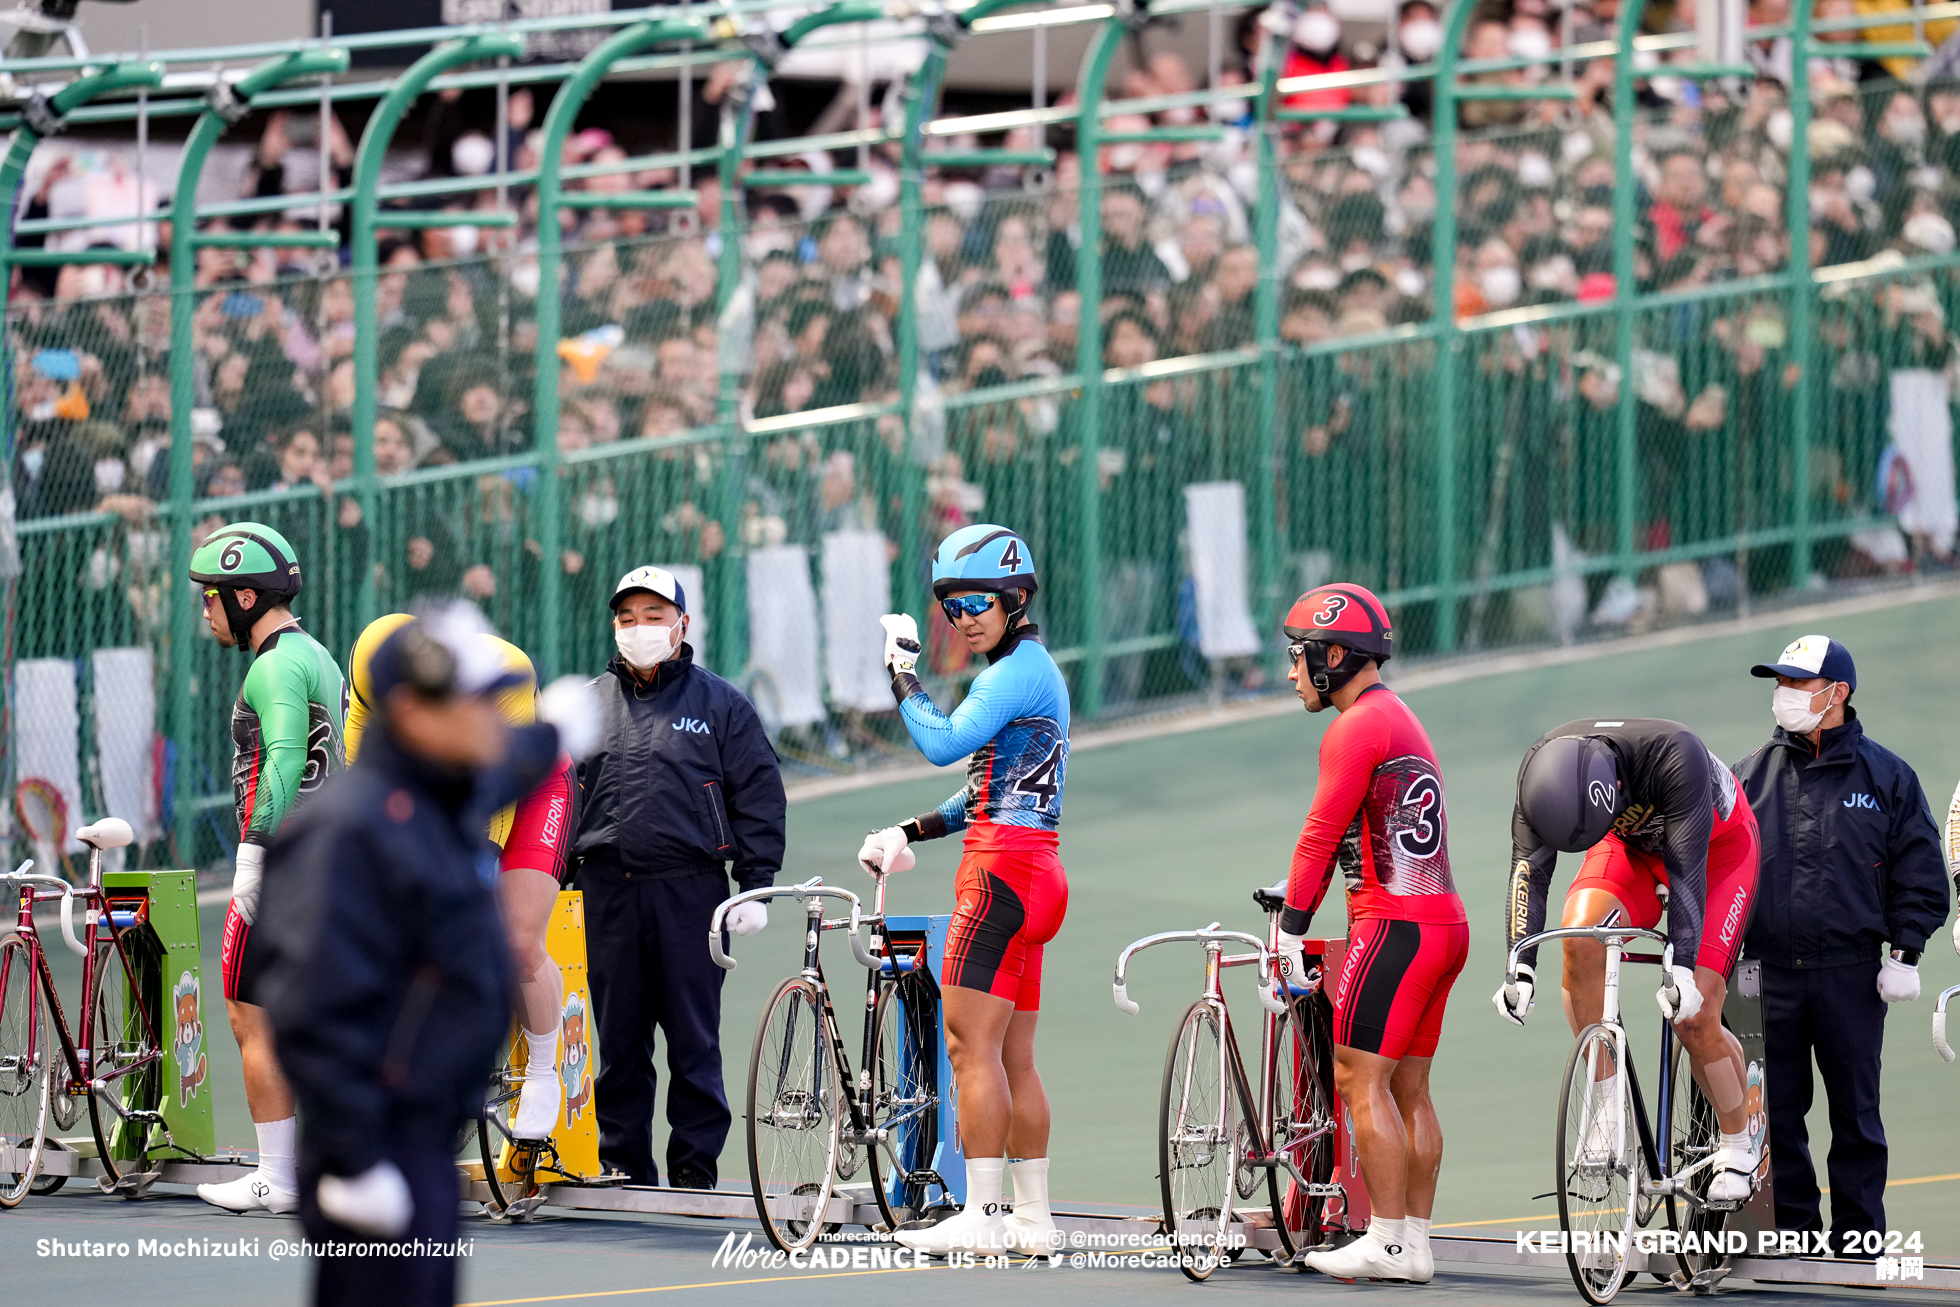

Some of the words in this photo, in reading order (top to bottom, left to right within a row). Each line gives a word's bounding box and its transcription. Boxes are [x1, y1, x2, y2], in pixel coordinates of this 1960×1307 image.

[219, 539, 248, 572] 6
[998, 539, 1022, 575] 4
[1313, 595, 1348, 627] 3
[672, 717, 710, 734] JKA
[1011, 740, 1059, 812] 4
[1589, 780, 1615, 814] 2
[1843, 793, 1880, 811] JKA
[540, 795, 565, 848] KEIRIN
[1396, 773, 1442, 859] 3
[1516, 879, 1530, 935] KEIRIN
[1719, 885, 1747, 947] KEIRIN
[222, 904, 241, 964] KEIRI
[1335, 937, 1365, 1010] KEIRIN
